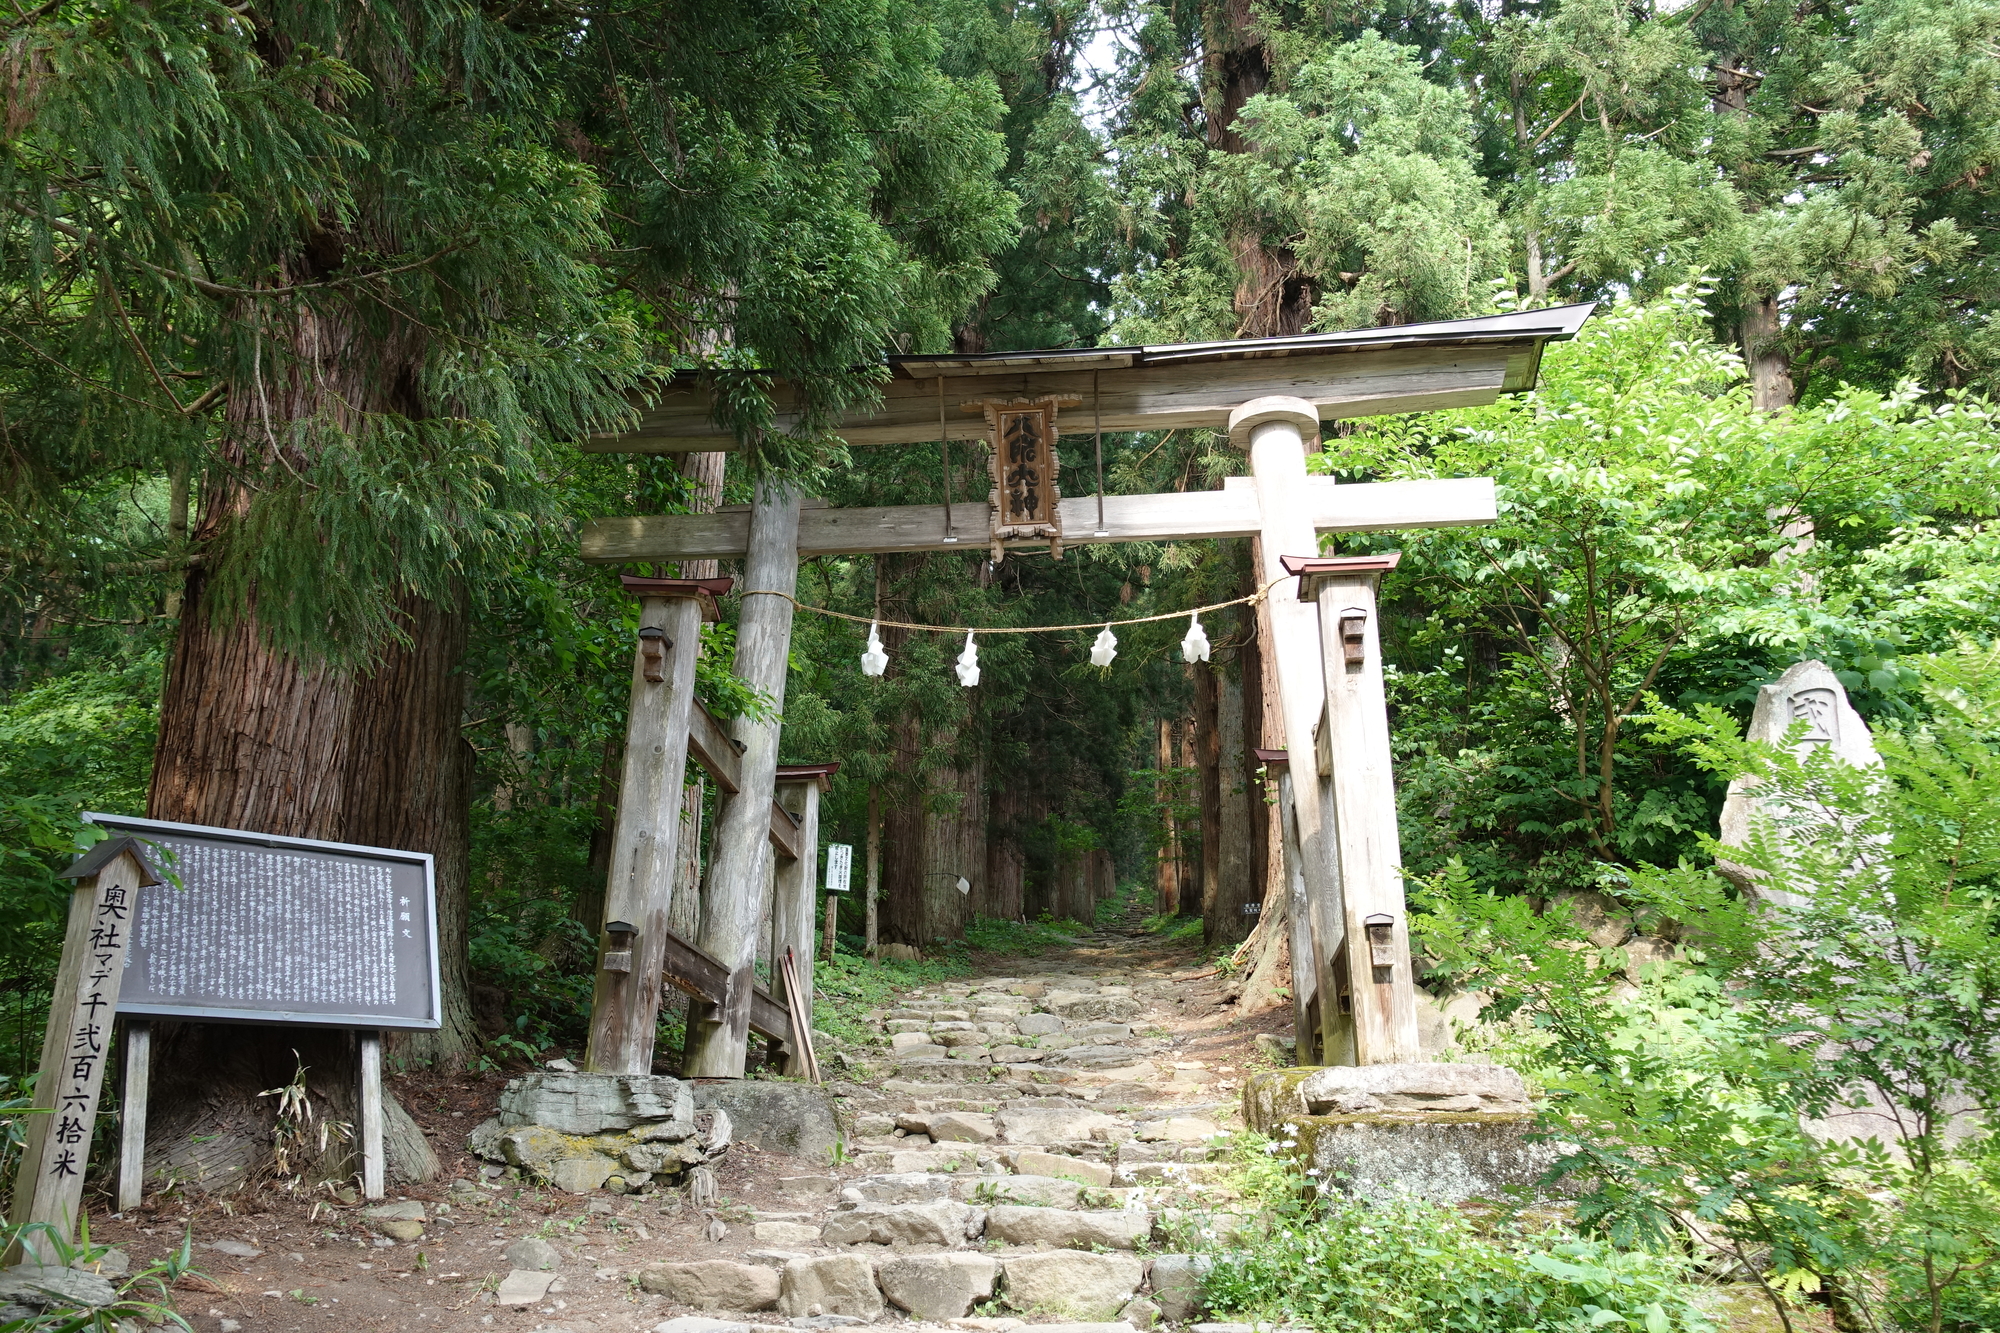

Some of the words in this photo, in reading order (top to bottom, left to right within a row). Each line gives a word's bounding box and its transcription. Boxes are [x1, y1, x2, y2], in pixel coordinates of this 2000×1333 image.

[398, 895, 413, 939] 祈願文
[50, 884, 128, 1180] 奥社マデ千弐百六拾米
